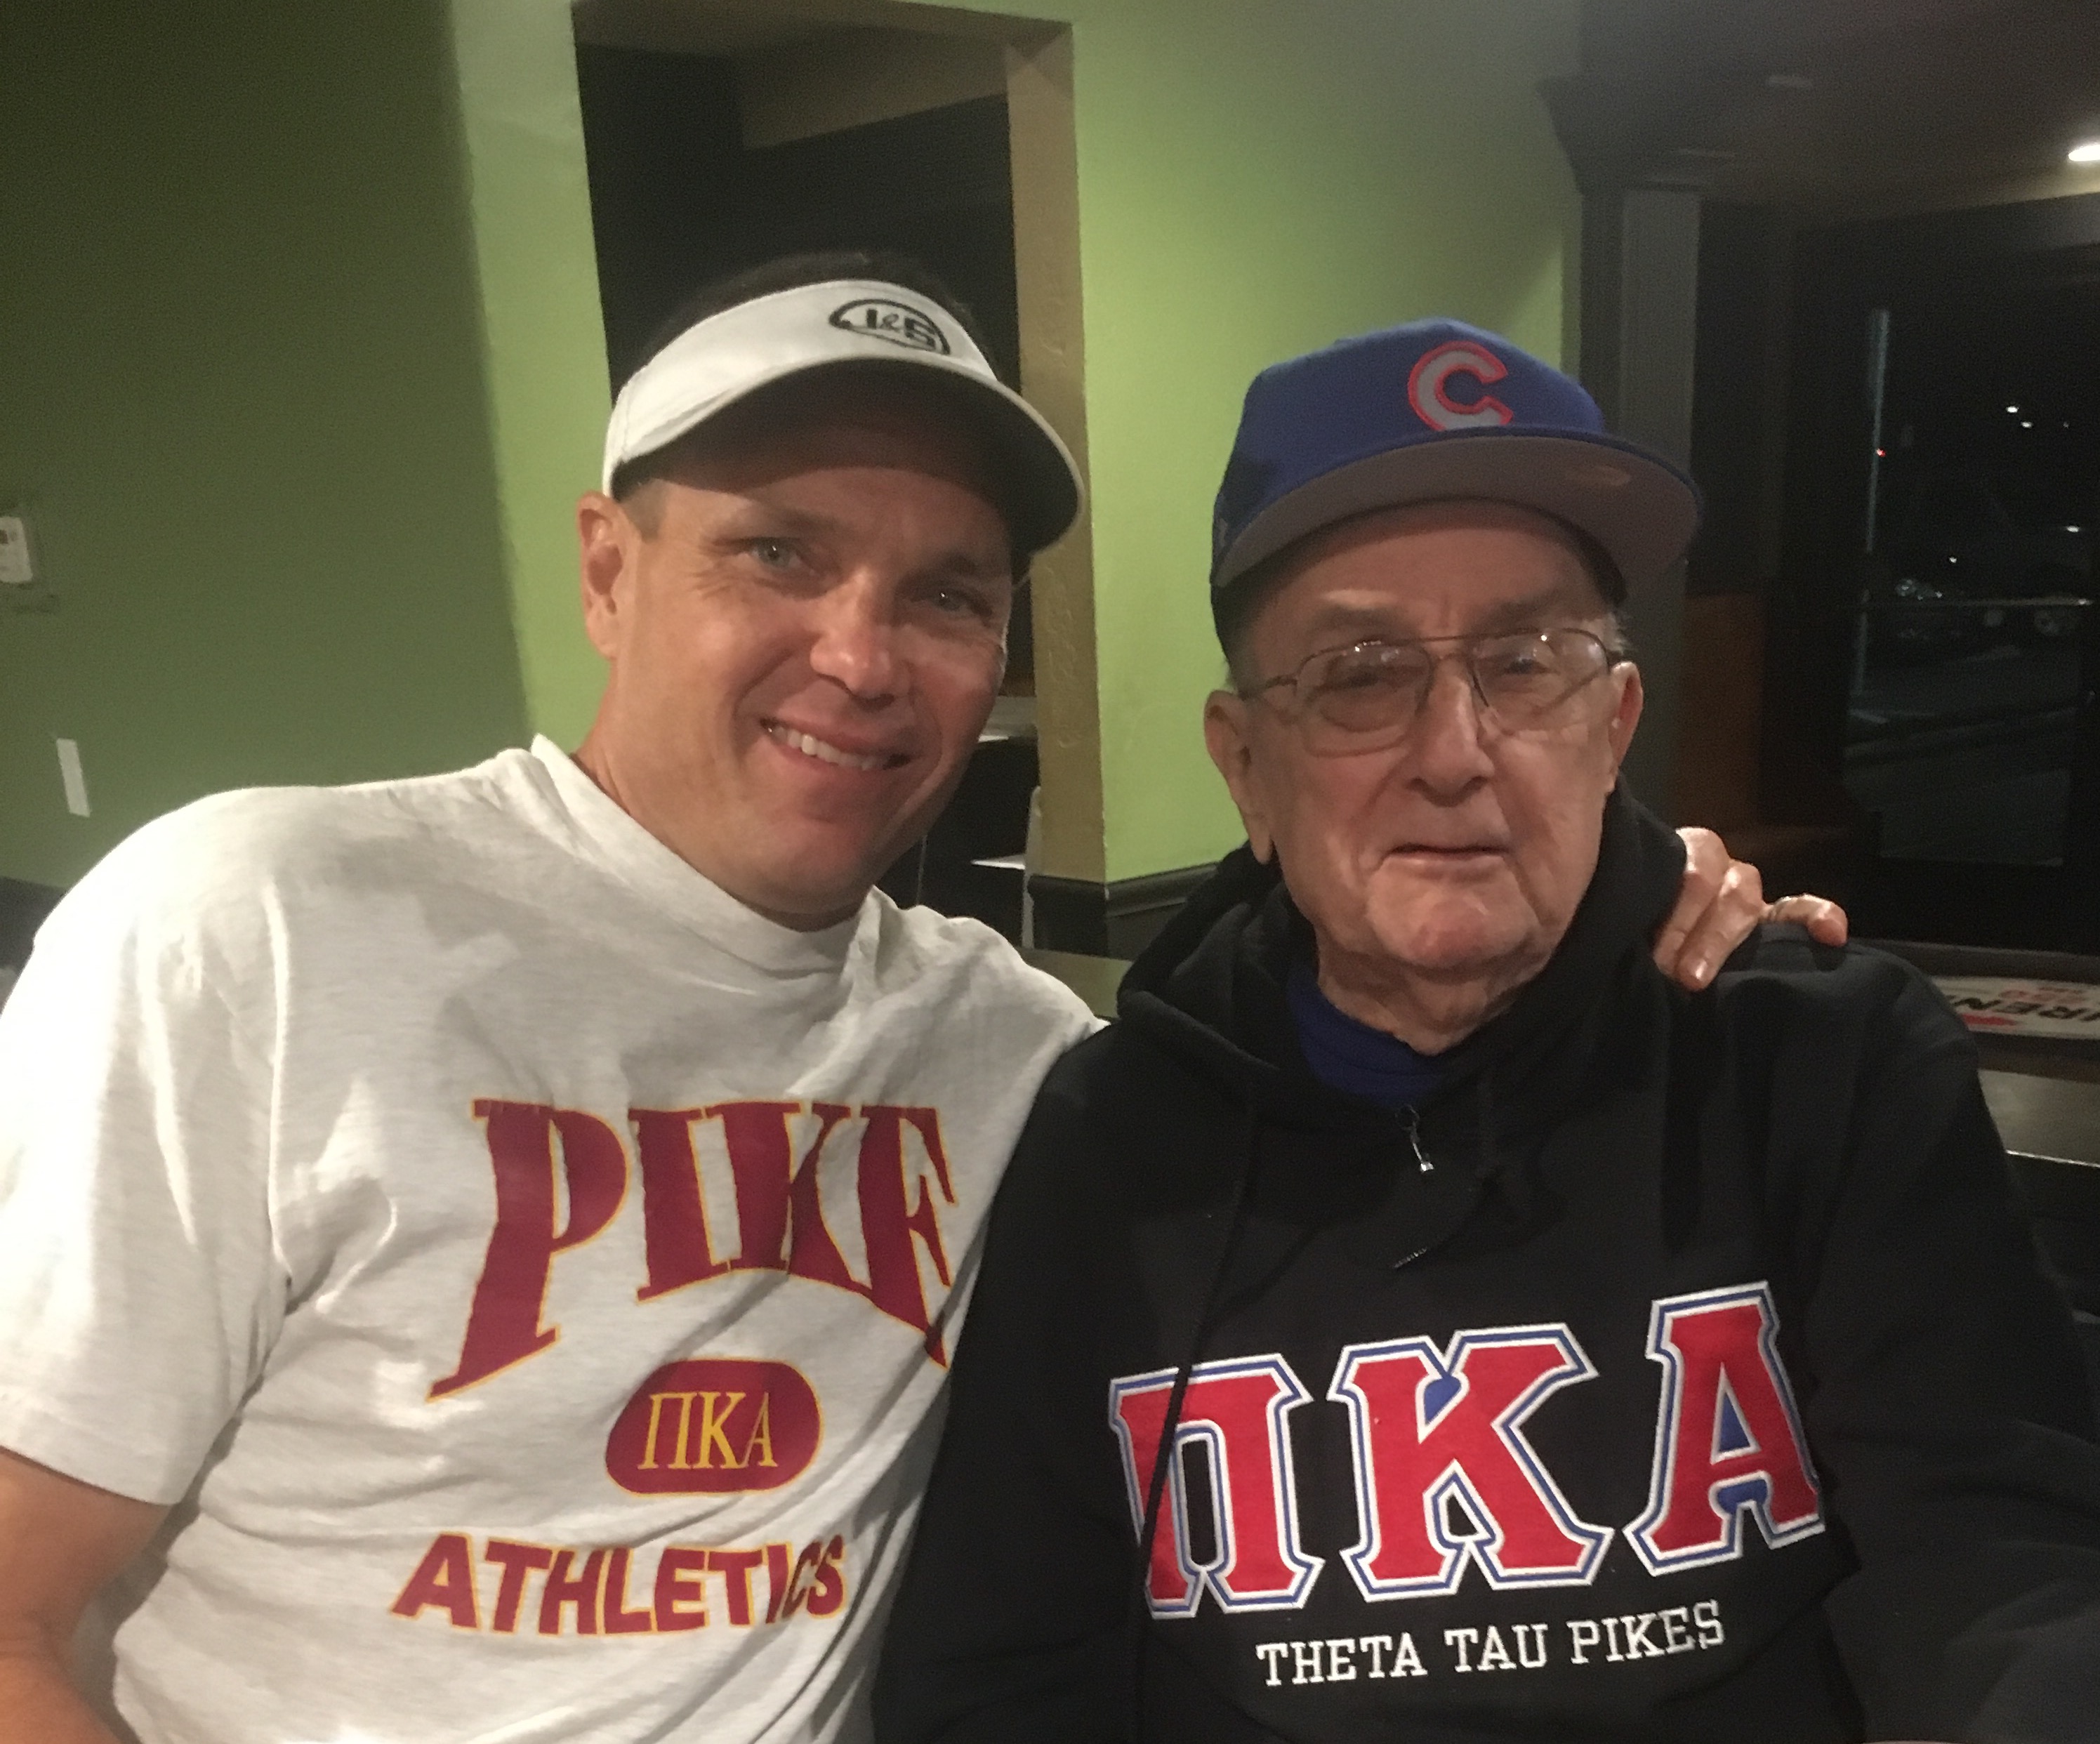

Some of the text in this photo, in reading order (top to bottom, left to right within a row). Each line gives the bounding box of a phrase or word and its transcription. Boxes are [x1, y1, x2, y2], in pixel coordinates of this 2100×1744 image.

[1407, 341, 1513, 431] C
[425, 1099, 958, 1403] PIKE
[390, 1531, 847, 1635] ATHLETICS
[1257, 1601, 1724, 1686] THETA TAU PIKES
